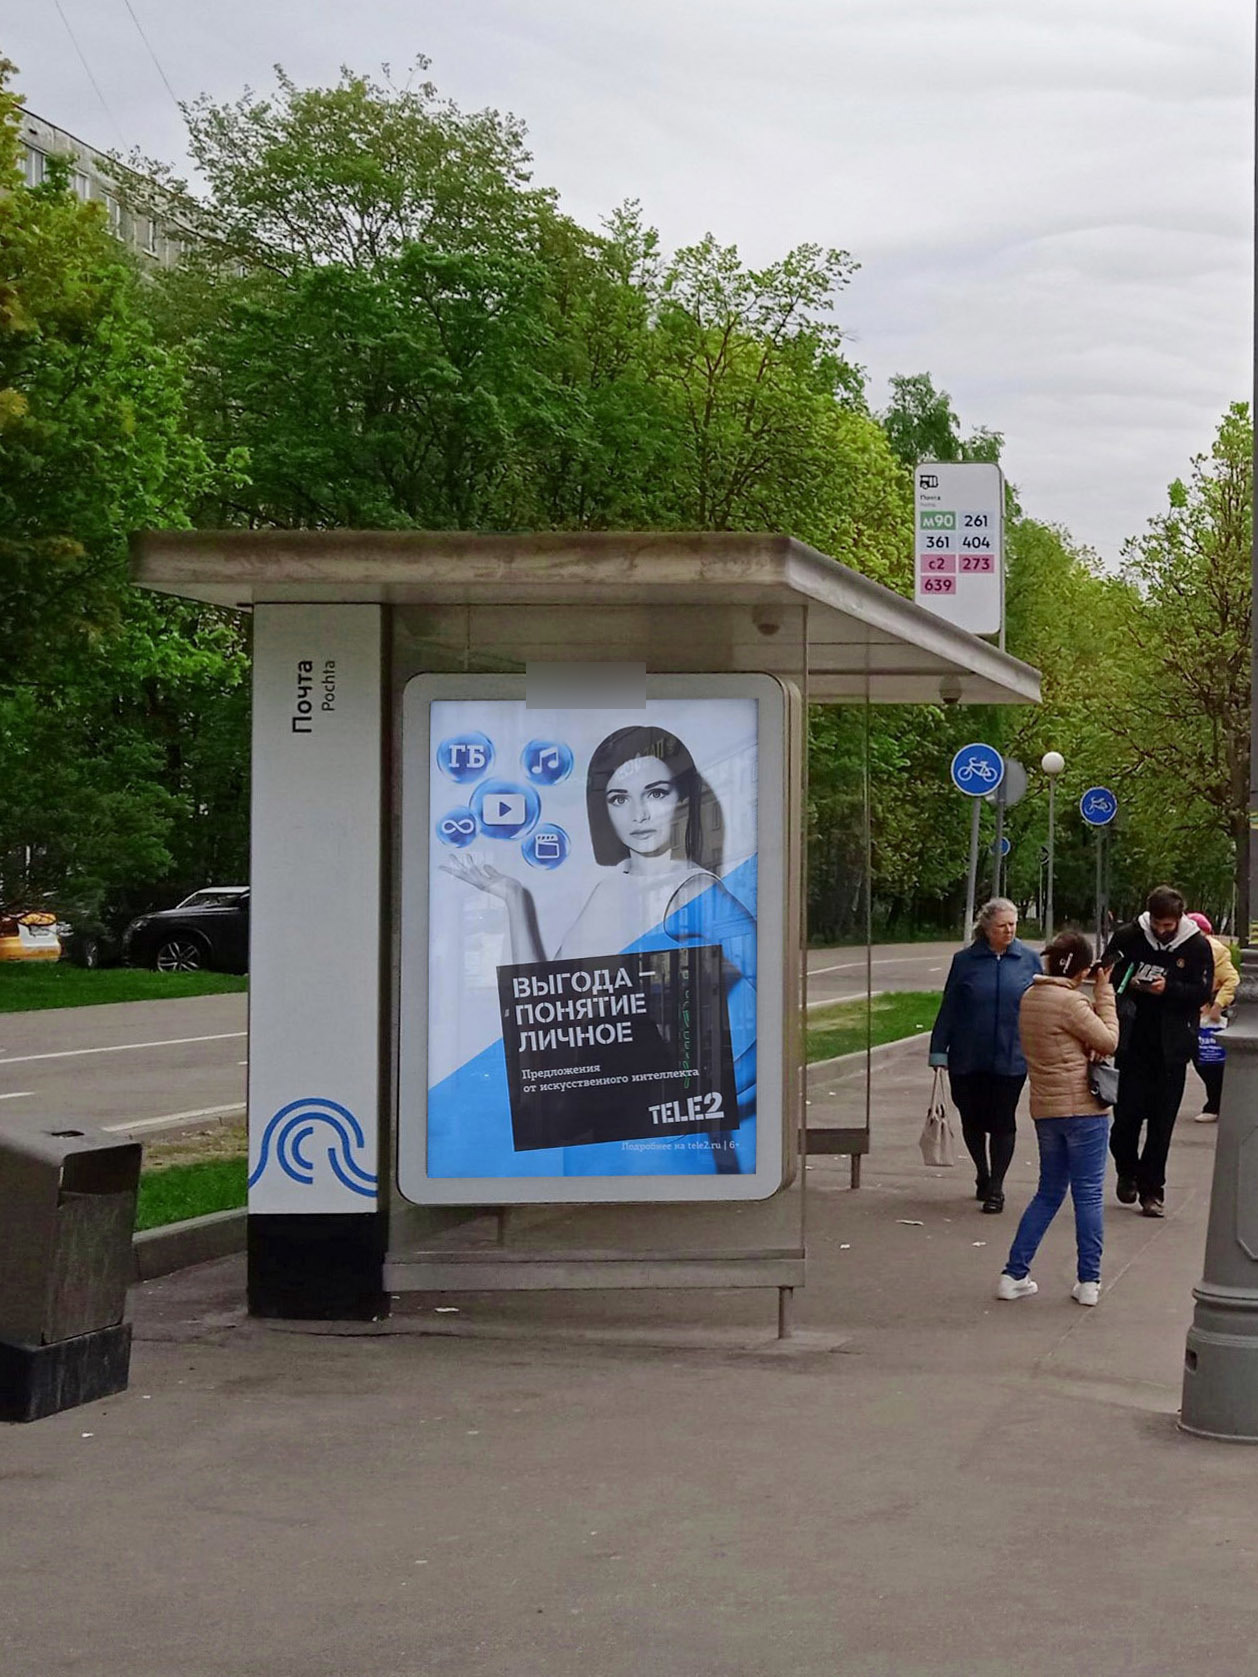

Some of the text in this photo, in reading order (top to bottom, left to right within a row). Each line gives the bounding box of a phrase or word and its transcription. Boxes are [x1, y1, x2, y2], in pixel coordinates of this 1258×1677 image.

[922, 515, 988, 527] м90 261
[926, 536, 990, 549] 361 404
[962, 558, 990, 570] 273
[924, 579, 952, 591] 639
[292, 660, 313, 733] Почта
[321, 660, 336, 711] Pochta
[448, 744, 487, 769] ГБ
[512, 967, 633, 998] ВЫГОДА
[515, 993, 647, 1026] ПОНЯТИЕ
[518, 1021, 633, 1052] ЛИЧНОЕ
[521, 1064, 601, 1080] Предложения
[523, 1068, 700, 1093] от искусственного интеллекта
[648, 1091, 724, 1125] TELE2
[687, 1142, 721, 1150] tele2.ru
